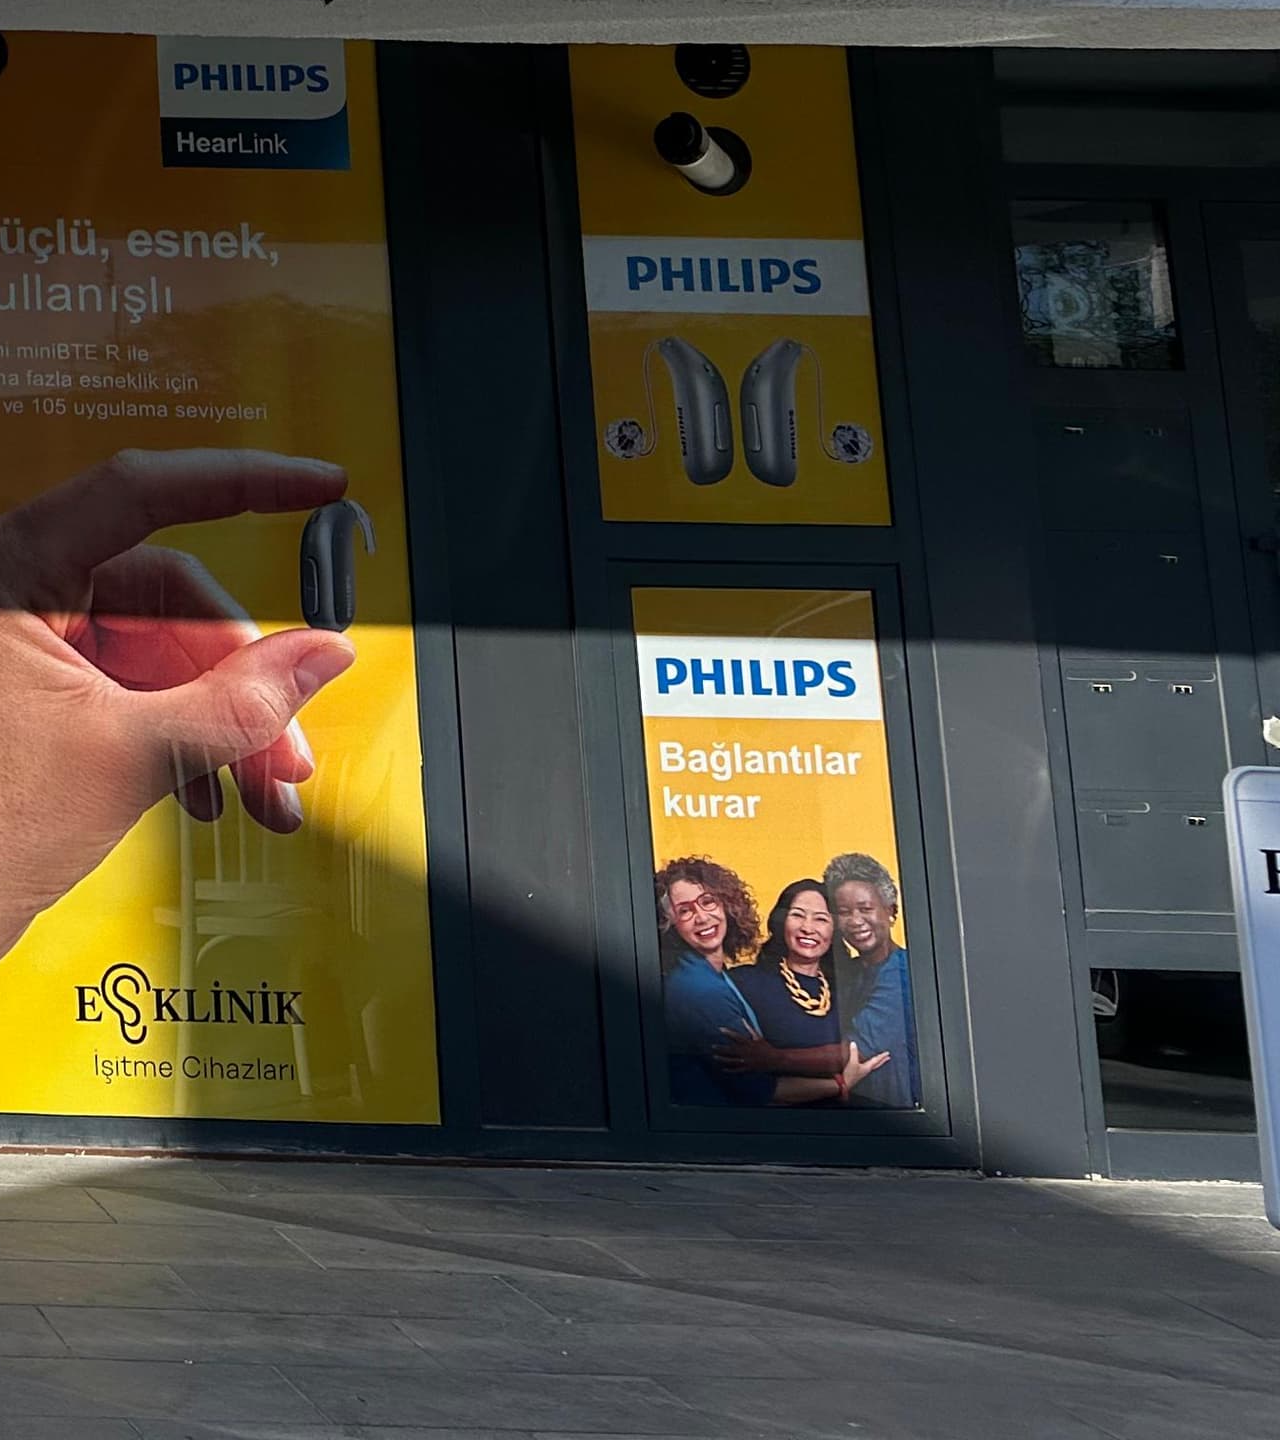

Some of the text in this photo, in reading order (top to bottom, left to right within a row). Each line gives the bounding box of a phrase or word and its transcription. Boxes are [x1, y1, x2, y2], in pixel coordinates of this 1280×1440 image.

[174, 62, 329, 93] PHILIPS
[176, 131, 289, 155] HearLink
[127, 221, 280, 267] esnek,
[626, 255, 822, 294] PHILIPS
[106, 344, 121, 361] R
[127, 344, 149, 362] ile
[26, 370, 72, 388] fazla
[79, 371, 159, 390] esneklik
[166, 373, 199, 394] için
[3, 400, 24, 414] ve
[32, 397, 66, 416] 105
[74, 399, 169, 421] uygulama
[175, 402, 268, 424] seviyeleri
[655, 657, 857, 698] PHILIPS
[658, 741, 863, 782] Bağlantılar
[662, 786, 762, 819] kurar
[94, 1049, 296, 1084] İşitme Cihazları
